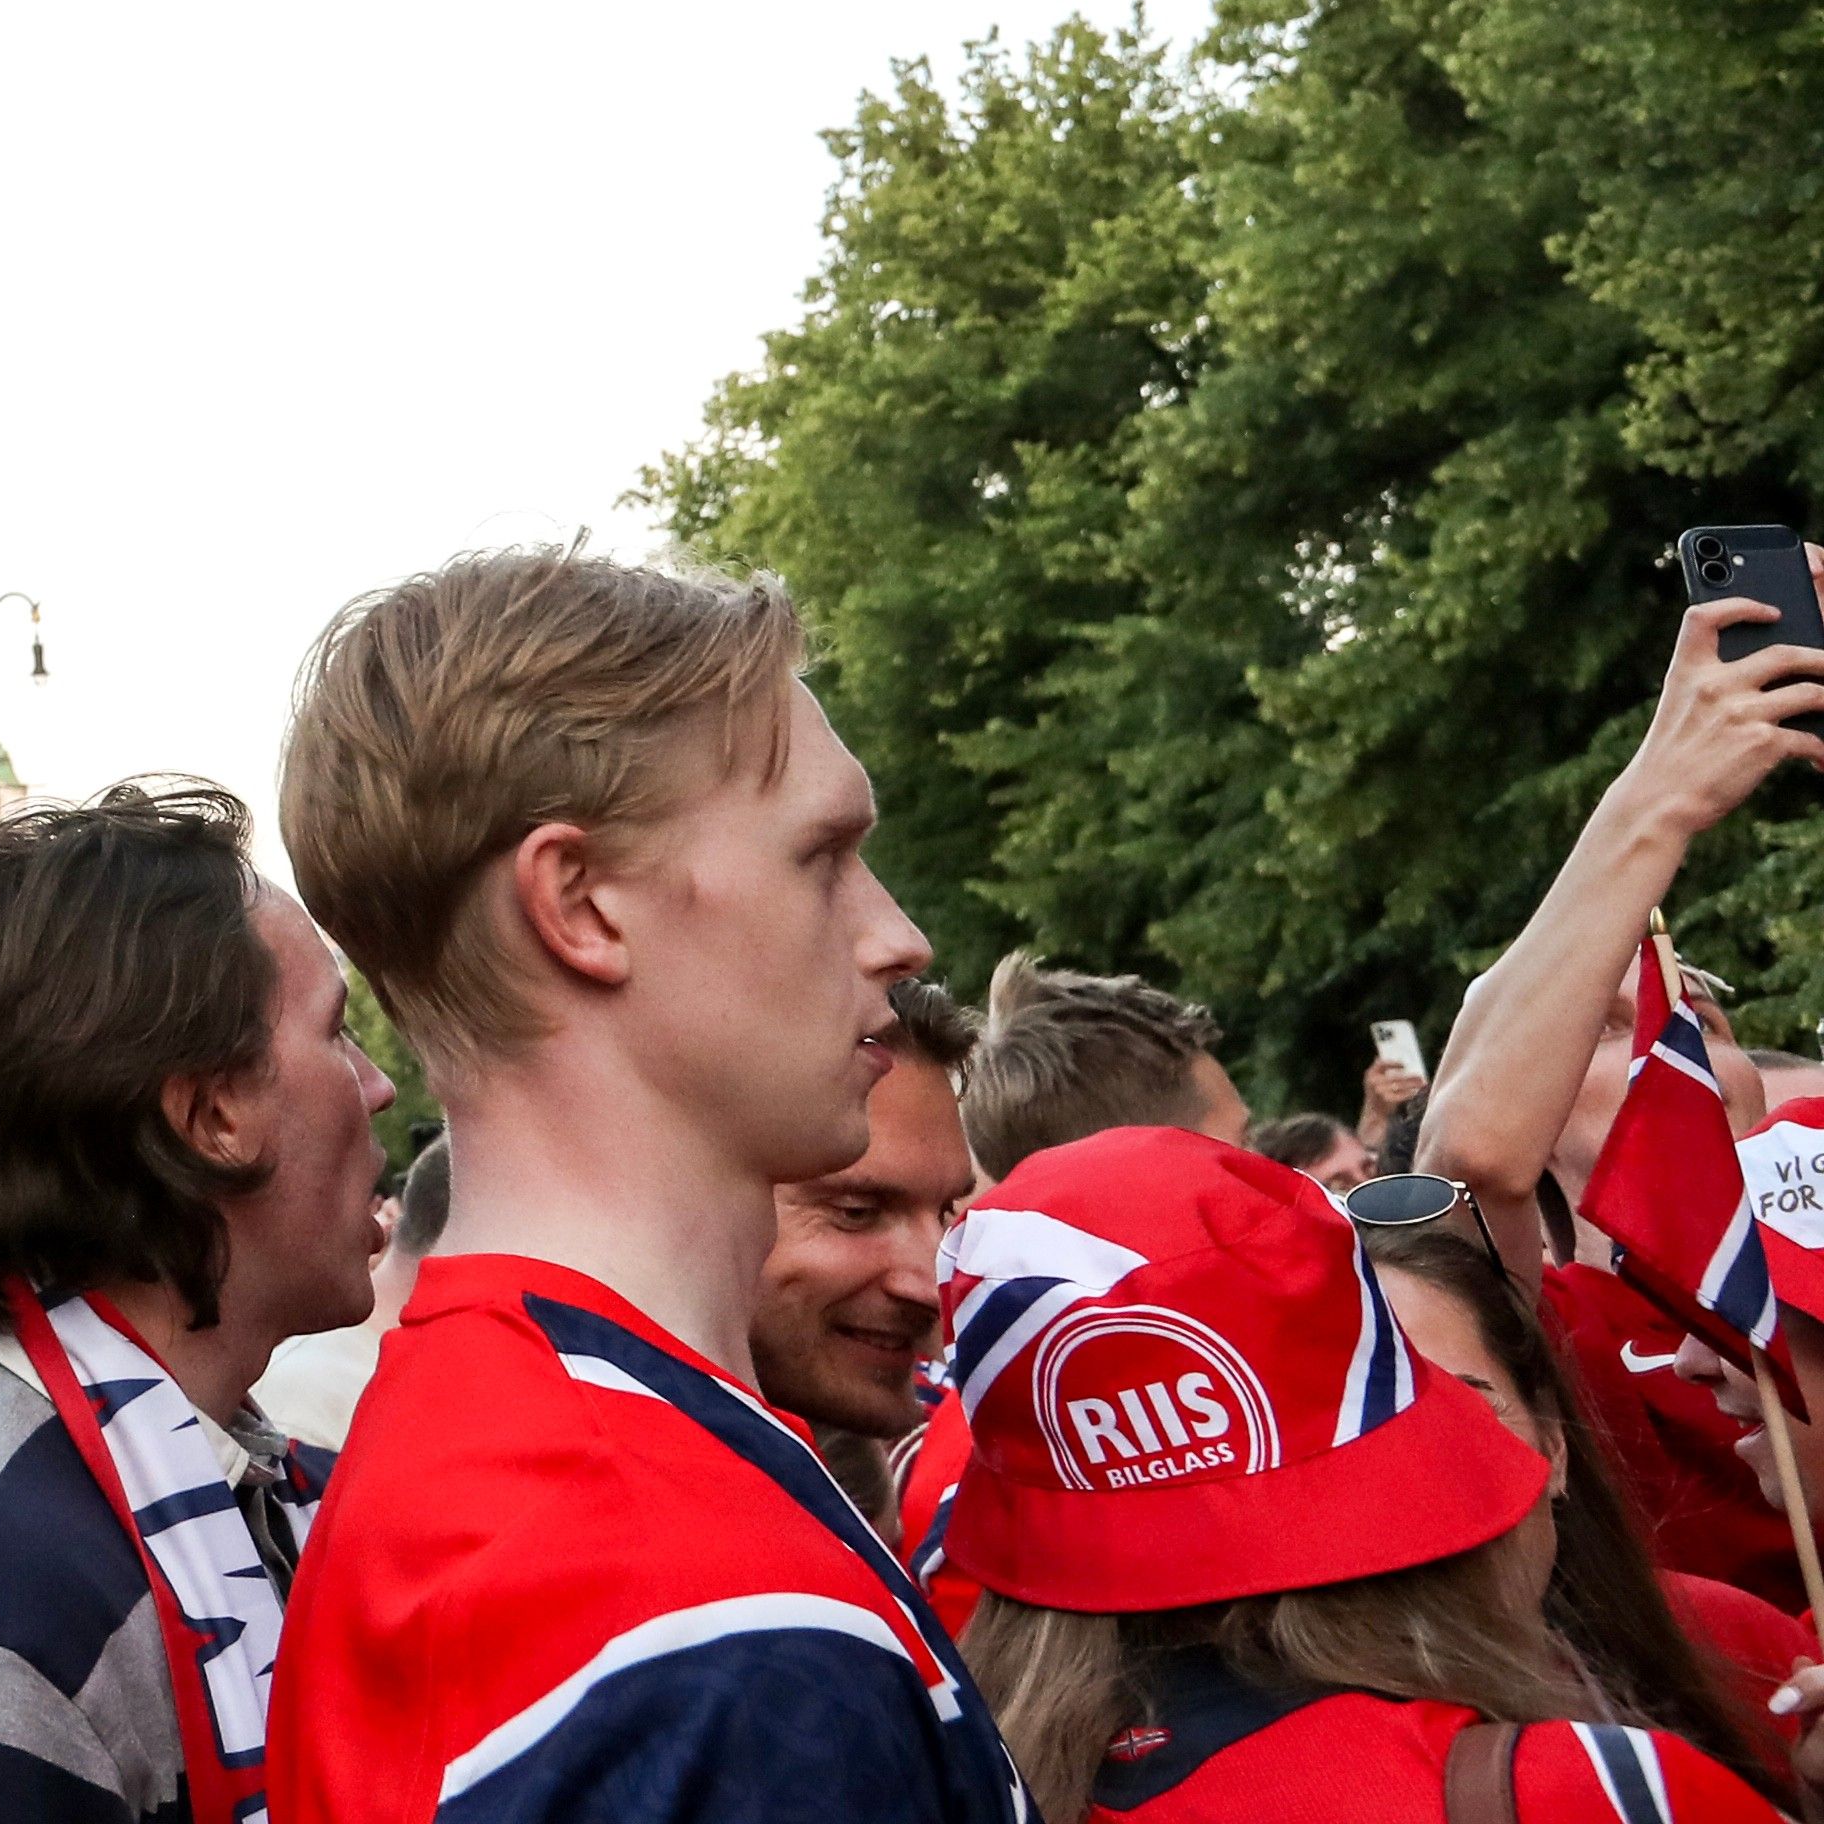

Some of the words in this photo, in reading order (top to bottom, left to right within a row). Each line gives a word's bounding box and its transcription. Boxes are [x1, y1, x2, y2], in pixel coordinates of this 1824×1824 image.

[1774, 1155, 1803, 1183] VI
[1758, 1184, 1824, 1218] FOR
[1066, 1371, 1230, 1465] RIIS
[1105, 1442, 1236, 1489] BILGLASS
